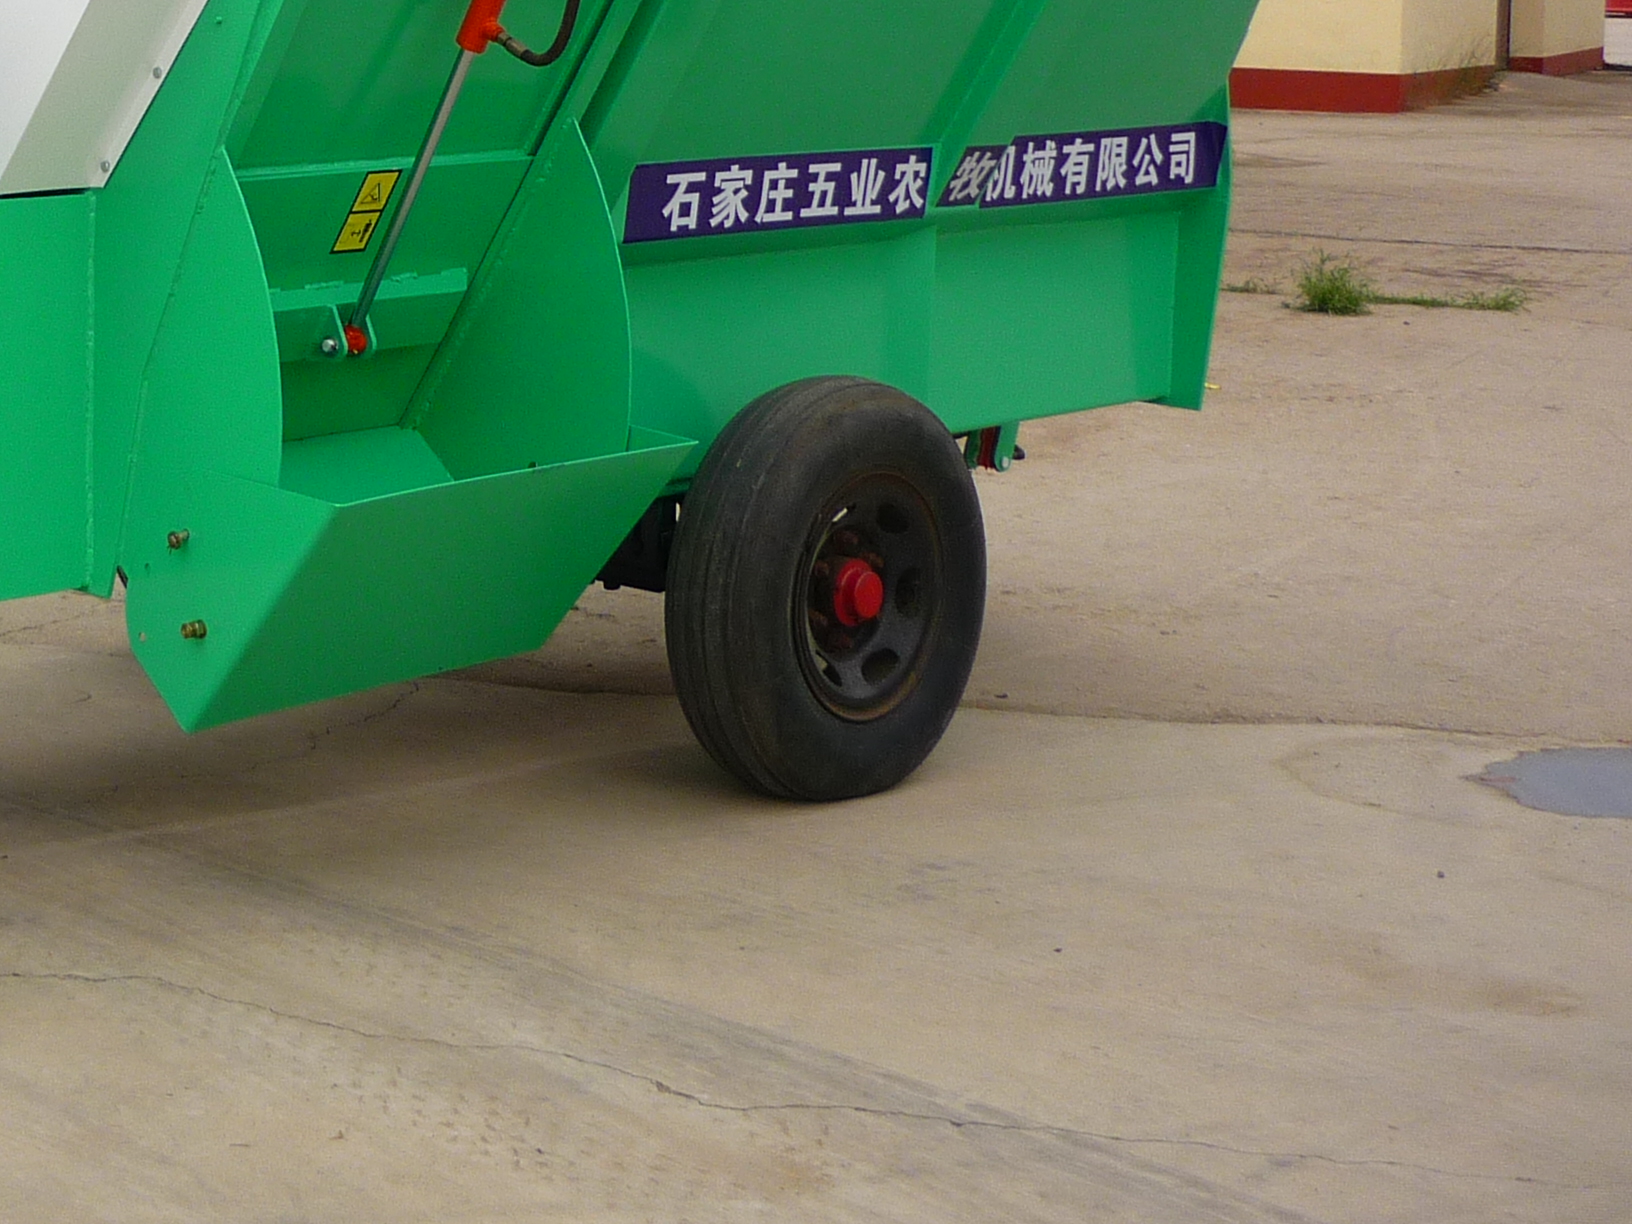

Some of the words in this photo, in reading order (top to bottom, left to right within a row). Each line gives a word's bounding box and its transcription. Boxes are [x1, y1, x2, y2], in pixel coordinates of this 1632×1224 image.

[662, 131, 1196, 231] 石家庄五业农牧机械有限公司
